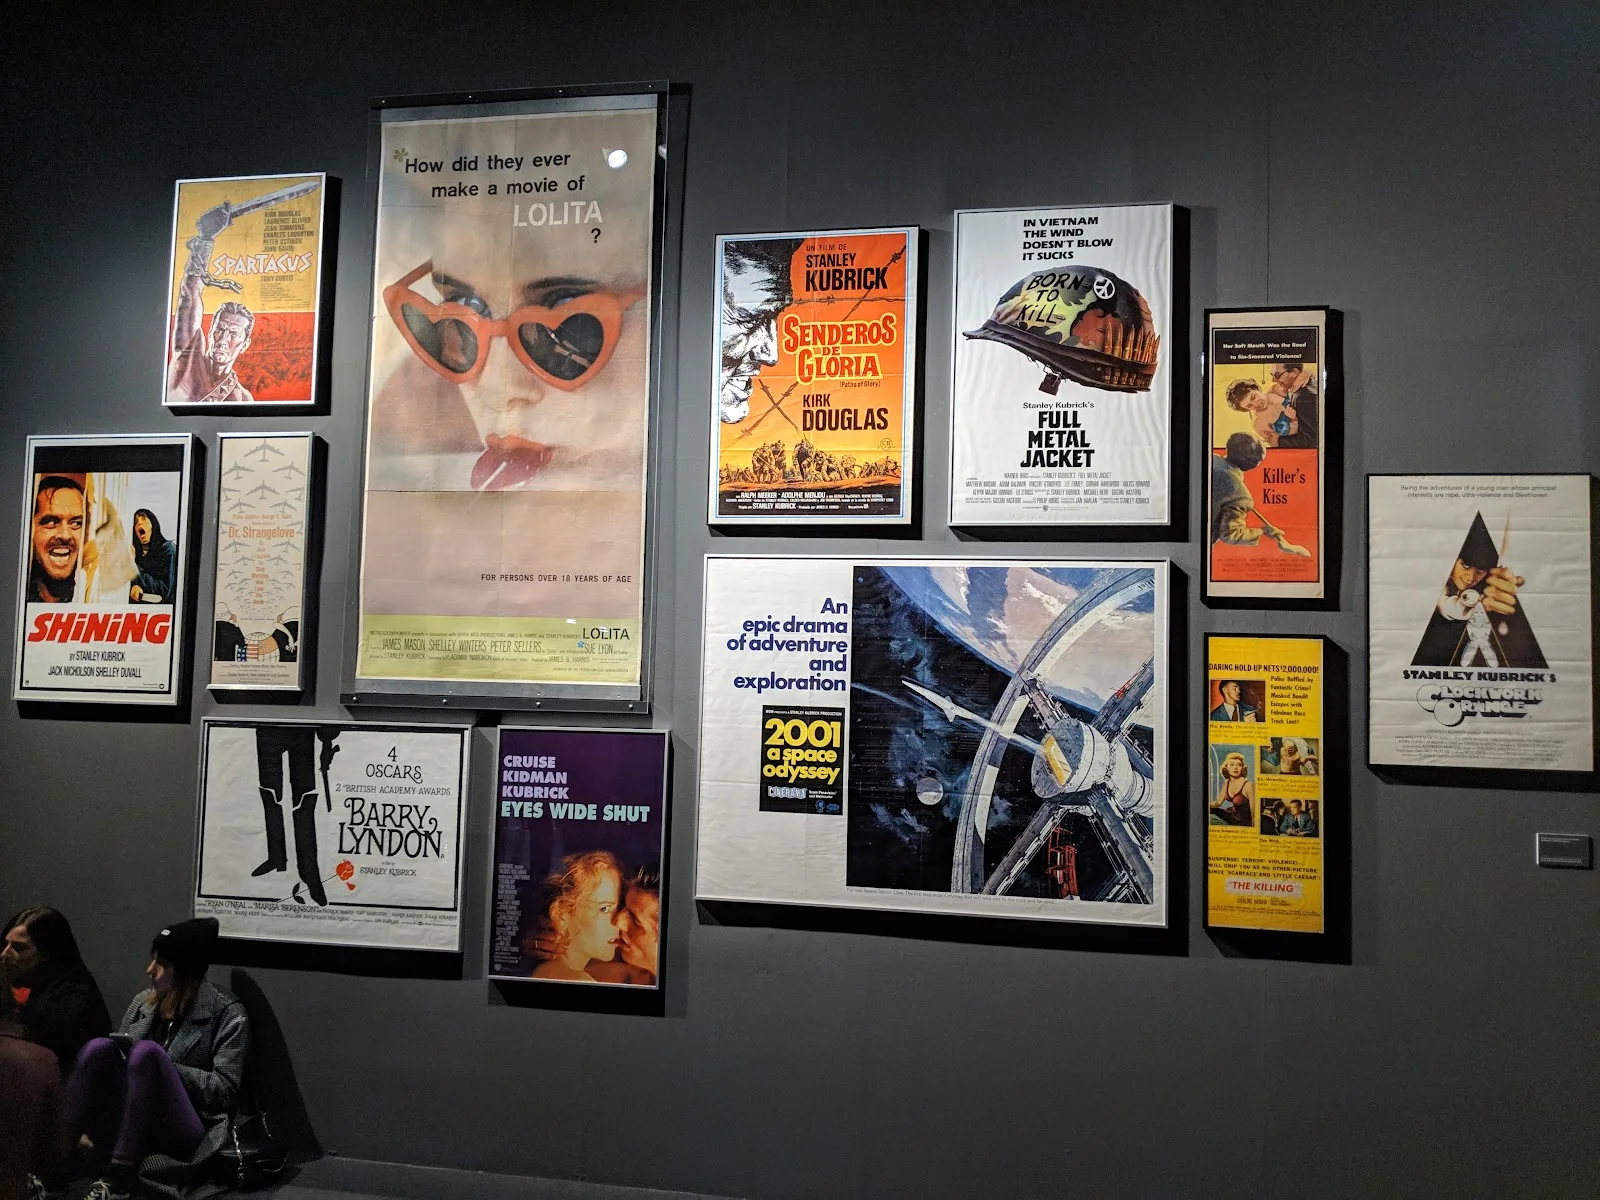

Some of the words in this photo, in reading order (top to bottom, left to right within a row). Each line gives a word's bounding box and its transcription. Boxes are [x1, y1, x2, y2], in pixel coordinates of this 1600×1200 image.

[405, 158, 443, 173] How
[452, 156, 478, 171] did
[487, 155, 524, 171] they
[533, 153, 571, 167] ever
[432, 182, 478, 197] make
[488, 184, 497, 194] a
[507, 178, 558, 194] movie
[567, 175, 585, 191] of
[514, 201, 603, 226] LOLITA
[1024, 219, 1035, 227] IN
[1039, 217, 1098, 227] VIETNAM
[591, 228, 601, 243] ?
[1023, 230, 1047, 238] THE
[1050, 229, 1084, 237] WIND
[1023, 240, 1074, 249] DOESN'T
[1077, 238, 1113, 248] BLOW
[806, 253, 856, 267] STANLEY
[1037, 251, 1074, 260] SUCKS
[212, 251, 313, 277] SPARTACUS
[805, 267, 888, 292] KUBRICK
[1027, 273, 1085, 290] BORN
[1037, 289, 1059, 301] TO
[784, 314, 895, 353] SENDEROS
[823, 346, 840, 355] DE
[798, 349, 881, 383] GLORIA
[803, 394, 831, 407] KIRK
[803, 408, 888, 431] DOUGLAS
[1038, 411, 1082, 428] FULL
[1028, 430, 1090, 448] METAL
[1020, 450, 1095, 467] JACKET
[1263, 468, 1305, 483] Killer's
[1263, 489, 1288, 504] Kiss
[229, 527, 240, 538] Dr.
[243, 527, 295, 539] Strangelove
[821, 598, 847, 614] An
[583, 628, 629, 639] LOLITA
[743, 615, 780, 636] epic
[783, 616, 847, 634] drama
[382, 638, 402, 650] JAMES
[404, 639, 425, 651] MASON
[429, 639, 456, 651] SHELLEY
[459, 640, 486, 652] WINTERS
[491, 640, 511, 652] PETER
[514, 641, 541, 653] SELLERS
[585, 643, 596, 654] SUE
[599, 643, 613, 654] LYON
[727, 634, 746, 650] of
[749, 634, 847, 652] adventure
[76, 651, 100, 661] STANLEY
[101, 651, 125, 661] KUBRICK
[809, 655, 847, 671] and
[48, 666, 62, 676] JACK
[63, 666, 94, 676] NICHOLSON
[96, 667, 119, 677] SHELLEY
[121, 667, 142, 678] DUVALL
[1209, 663, 1233, 671] DARING
[734, 672, 846, 694] exploration
[1403, 670, 1473, 680] STANLEY
[1477, 672, 1556, 683] KUBRICK'S
[1416, 684, 1543, 712] CLOCKWORK
[1433, 700, 1528, 727] ORANGE
[765, 718, 841, 747] 2001
[388, 746, 397, 762] 4
[504, 755, 556, 768] CRUISE
[767, 748, 780, 760] a
[783, 748, 837, 765] space
[366, 764, 423, 784] OSCARS
[503, 770, 567, 784] KIDMAN
[763, 760, 840, 784] odyssey
[379, 786, 416, 794] ACADEMY
[502, 785, 569, 799] KUBRICK
[768, 786, 806, 799] CINERAMA
[344, 797, 435, 830] BARRY
[501, 801, 543, 818] EYES
[549, 803, 597, 820] WIDE
[603, 804, 650, 822] SHUT
[338, 822, 442, 858] LYNDON
